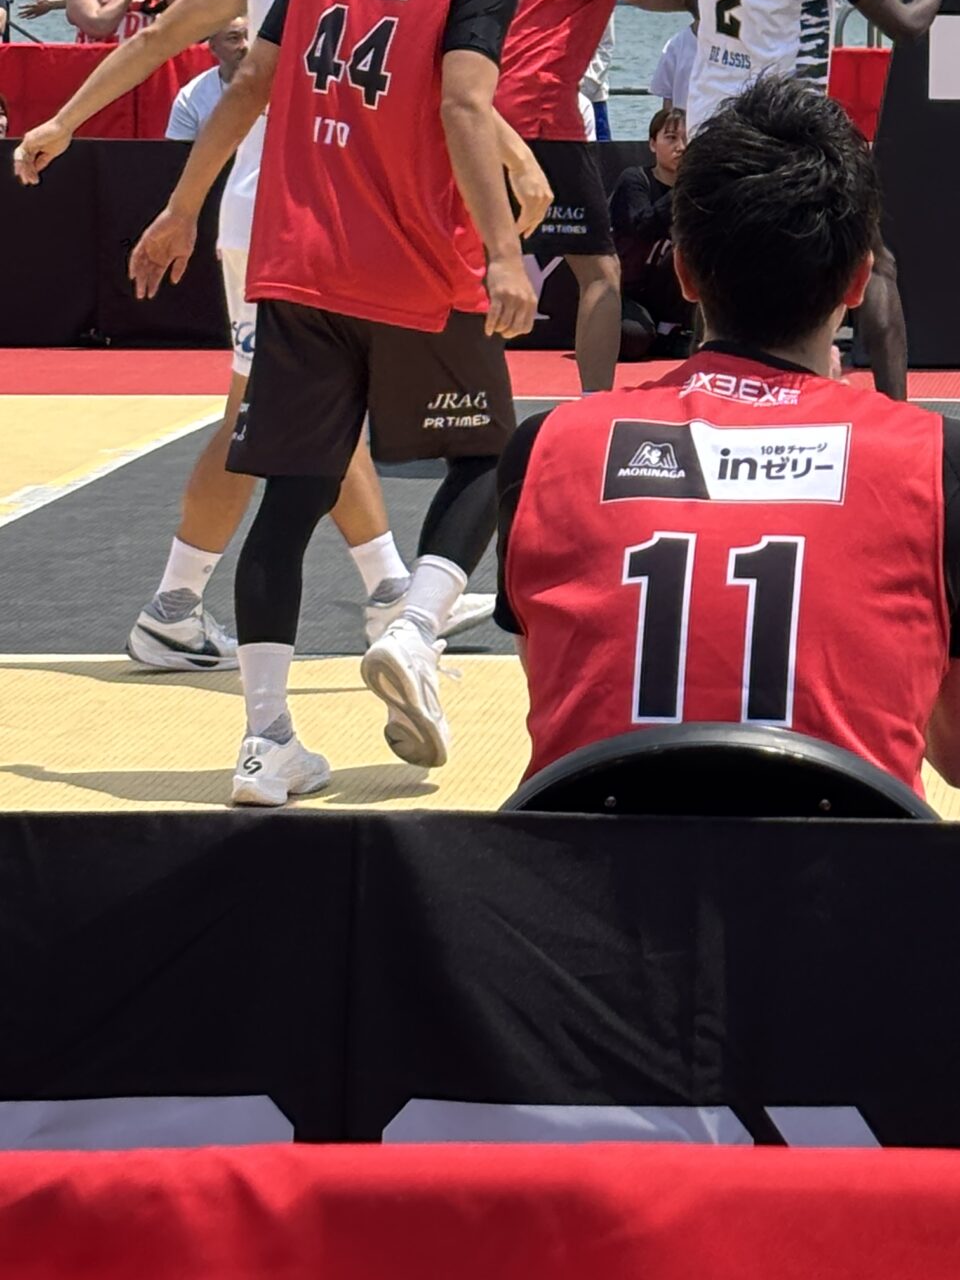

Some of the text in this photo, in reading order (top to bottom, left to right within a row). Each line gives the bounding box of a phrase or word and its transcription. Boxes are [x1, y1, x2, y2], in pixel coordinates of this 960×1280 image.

[303, 3, 400, 111] 44
[312, 116, 351, 149] ITO
[426, 391, 488, 410] JRAG
[761, 442, 828, 456] 10秒チャージ
[616, 467, 686, 479] MORINAGA
[621, 530, 806, 729] 11
